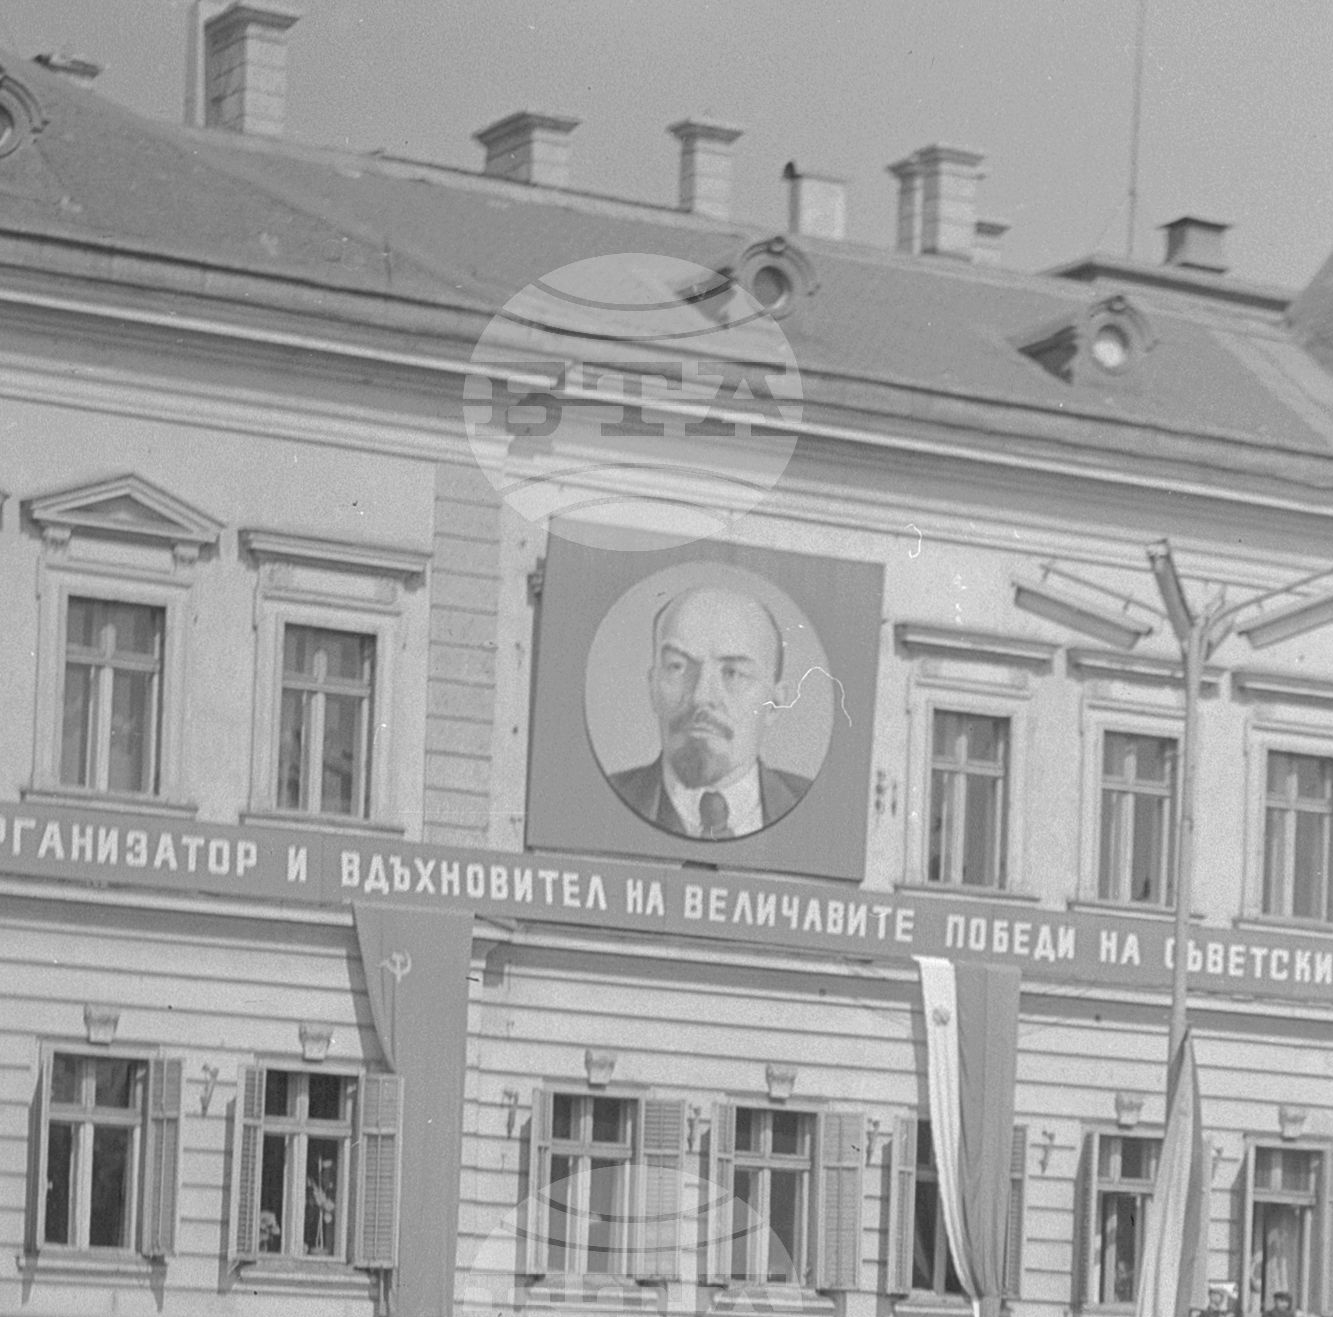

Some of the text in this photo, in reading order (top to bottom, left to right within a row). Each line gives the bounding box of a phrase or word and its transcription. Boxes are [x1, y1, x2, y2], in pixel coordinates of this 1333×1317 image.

[0, 814, 258, 876] ГАНИЗАТОР
[287, 846, 308, 882] И
[340, 850, 607, 910] ВДЪХНОВИТЕЛ
[626, 879, 665, 916] НА
[684, 884, 914, 943] ВЕЛИЧАВИТЕ
[945, 913, 1076, 962] ПОБЕДИ
[1100, 930, 1141, 966] НА
